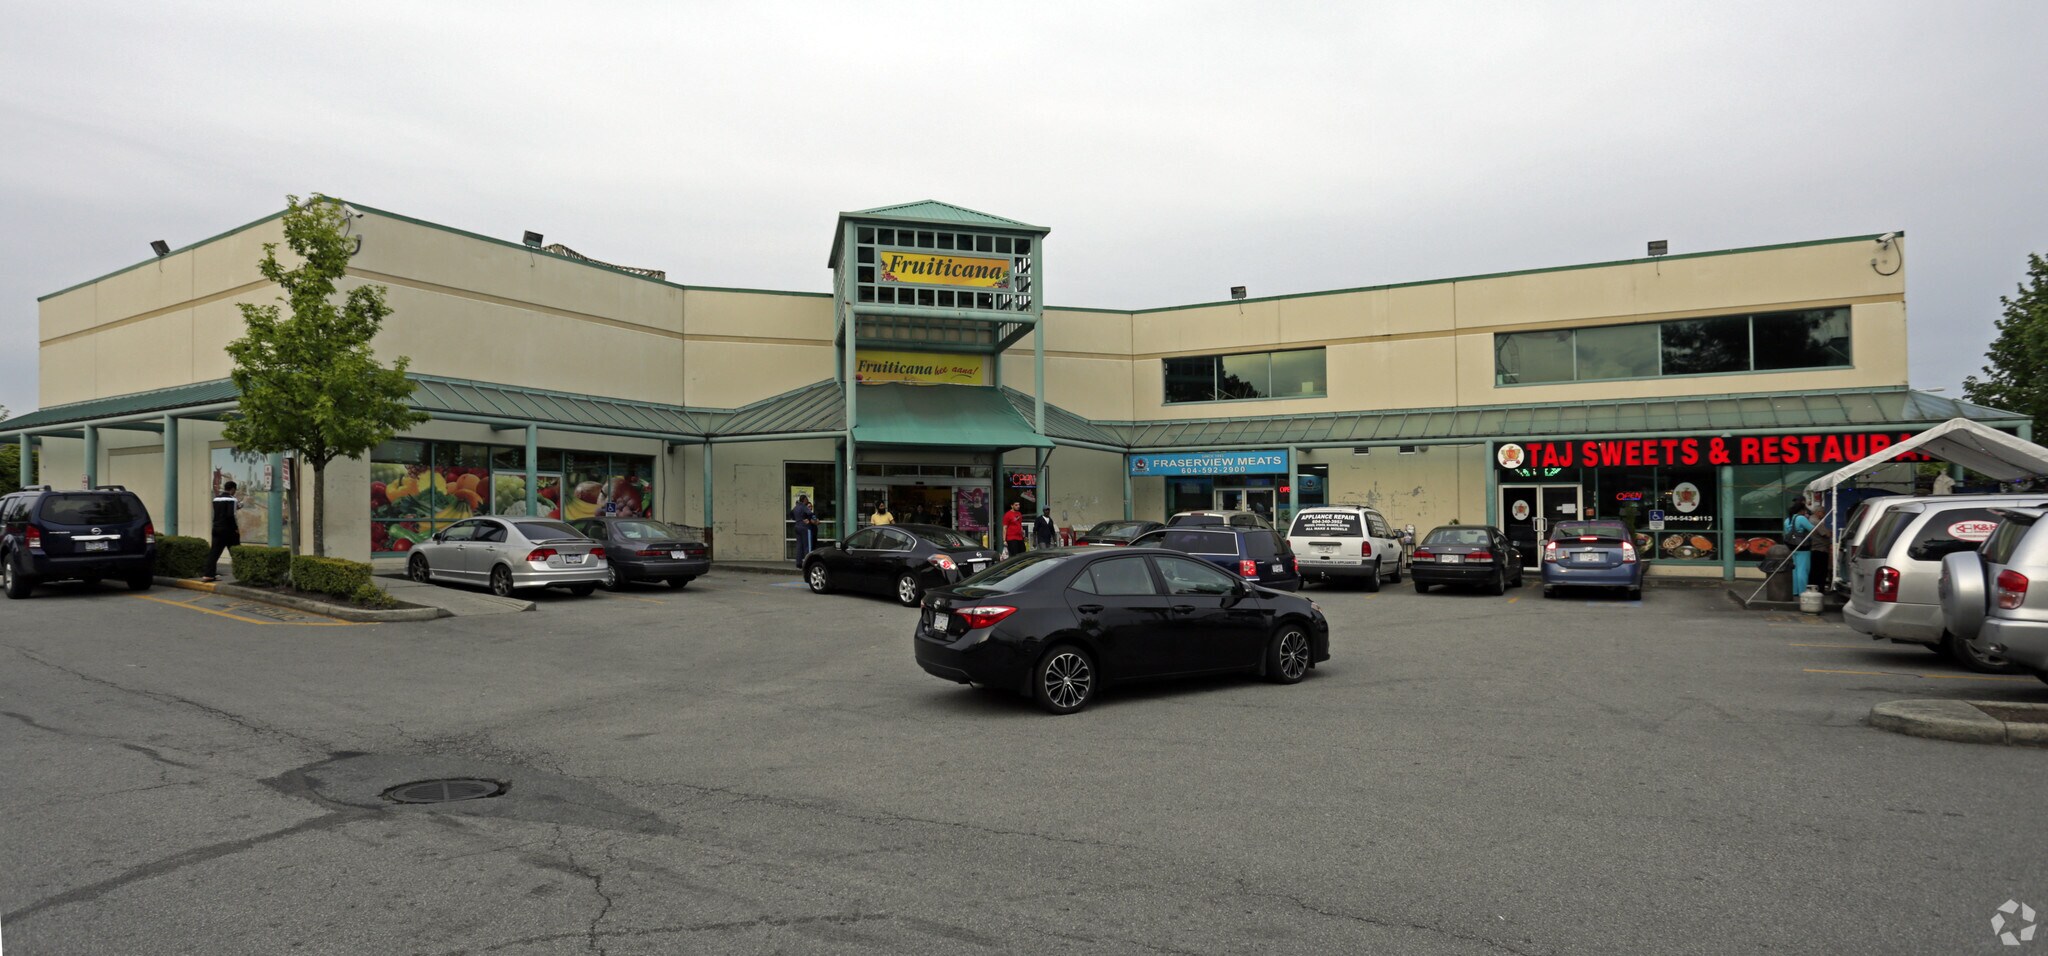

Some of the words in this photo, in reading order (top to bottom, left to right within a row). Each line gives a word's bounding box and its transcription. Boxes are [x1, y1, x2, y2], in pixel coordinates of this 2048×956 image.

[888, 254, 1002, 280] Fruiticana
[857, 360, 932, 375] Fruiticana
[1526, 441, 1573, 467] TAJ
[1582, 438, 1699, 467] SWEETS
[1708, 437, 1731, 465] &
[1740, 433, 1932, 464] RESTAURA
[1153, 457, 1234, 468] FRASERVIEW
[1237, 456, 1282, 466] MEATS
[1181, 466, 1246, 474] 604-592-2900
[1012, 473, 1036, 486] OPEN
[1615, 492, 1643, 501] OPEN
